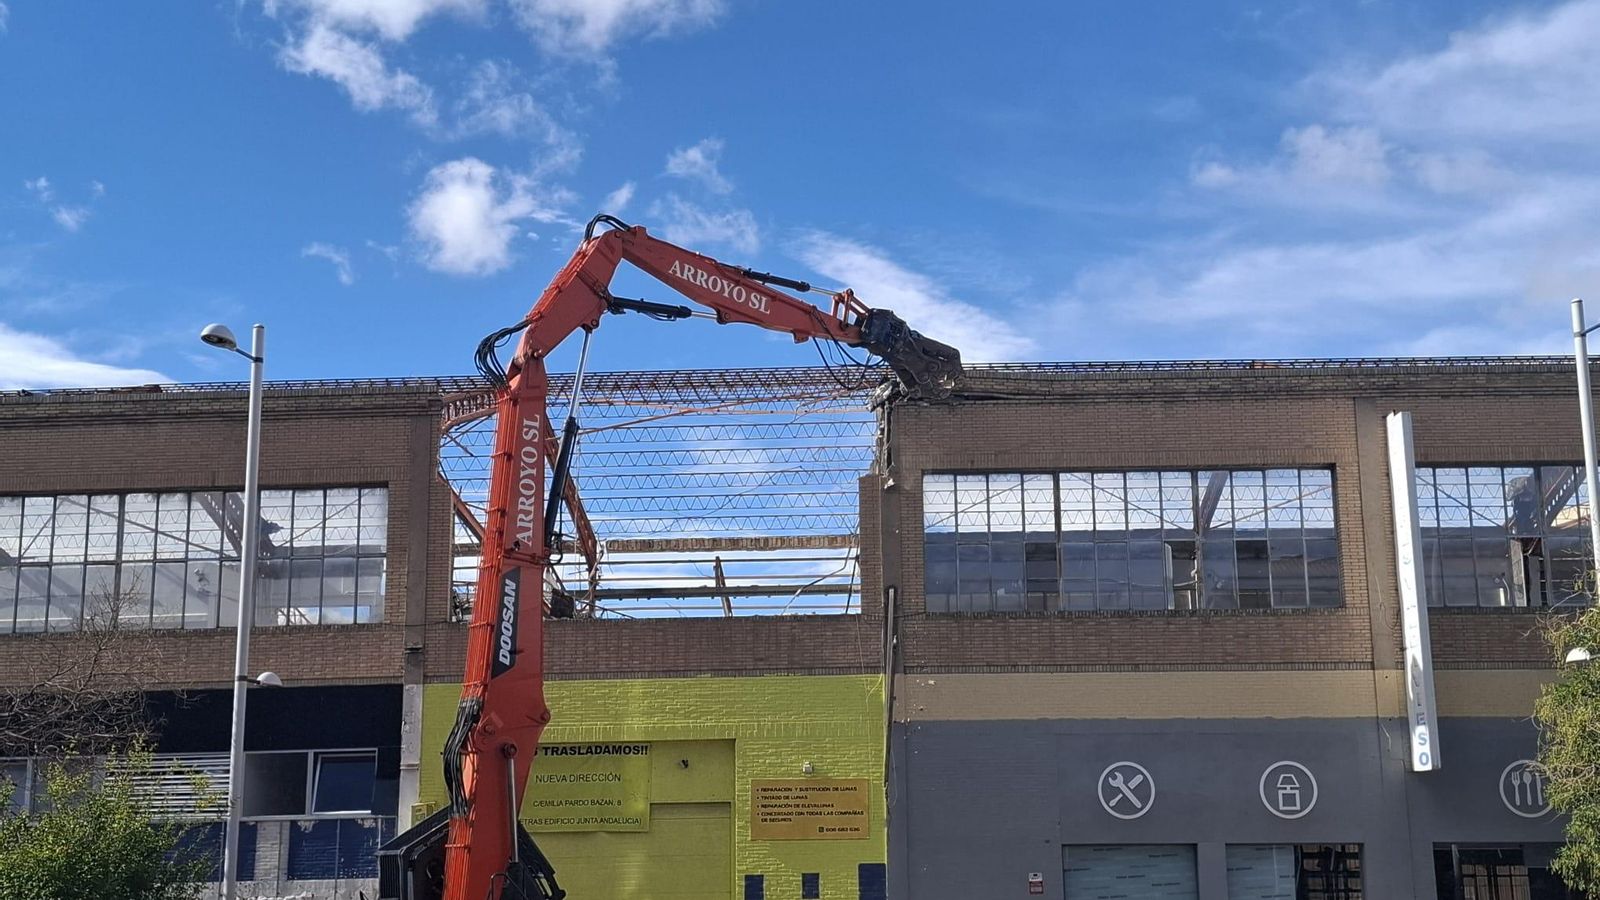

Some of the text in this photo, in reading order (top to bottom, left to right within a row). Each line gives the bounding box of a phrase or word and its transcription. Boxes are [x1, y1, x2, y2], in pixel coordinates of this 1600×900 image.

[668, 260, 771, 315] ARROYO SL
[516, 413, 541, 547] ARROYO SL
[499, 578, 517, 667] DOOSAN
[542, 745, 649, 756] TRASLADAMOS!!
[535, 772, 622, 783] NUEVA DIRECCIÓN
[564, 799, 590, 807] PARDO
[544, 817, 575, 825] EDIFICIO
[576, 817, 599, 825] JUNTA
